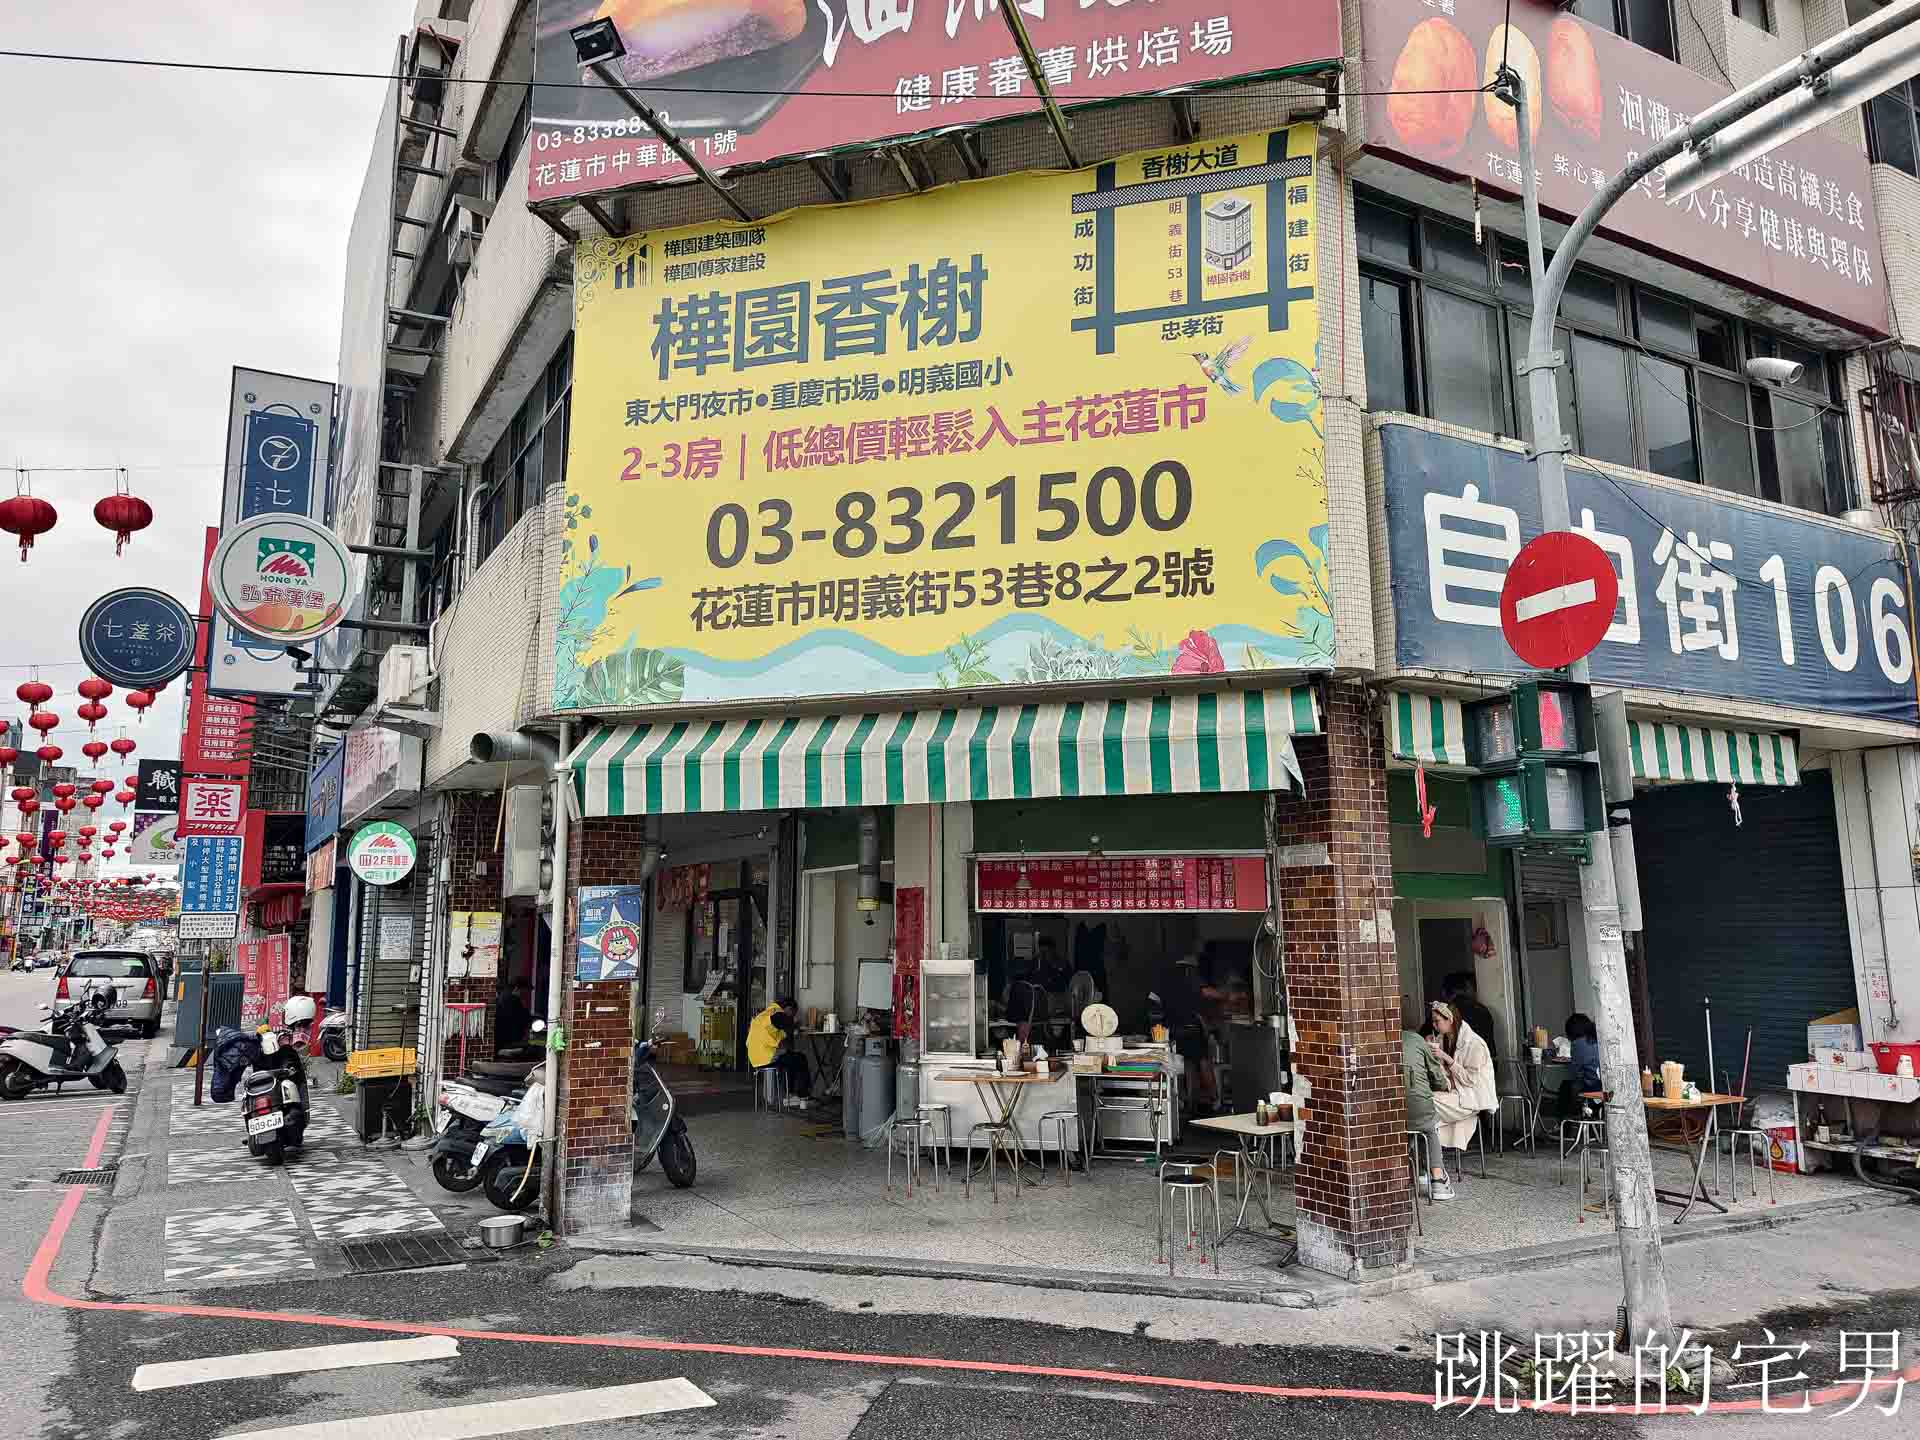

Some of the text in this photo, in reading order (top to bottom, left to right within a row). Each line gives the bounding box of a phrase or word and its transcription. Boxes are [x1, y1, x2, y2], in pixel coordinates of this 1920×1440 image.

[895, 16, 1234, 115] 健康蕃薯烘焙場
[1142, 144, 1239, 179] 香榭大道
[664, 225, 766, 258] 樺園建築團隊
[664, 252, 766, 283] 樺園傳家建設
[1073, 218, 1095, 306] 成功街
[1288, 185, 1309, 272] 福建街
[651, 253, 989, 381] 樺園香榭
[1161, 316, 1224, 342] 忠孝街
[763, 383, 1209, 471] 低總價輕鬆入主花蓮市
[705, 460, 1193, 568] 03-8321500
[240, 584, 325, 609] 弘爺漢堡
[260, 575, 292, 584] HONG
[690, 547, 1216, 632] 花蓮市明義街53巷8之2號
